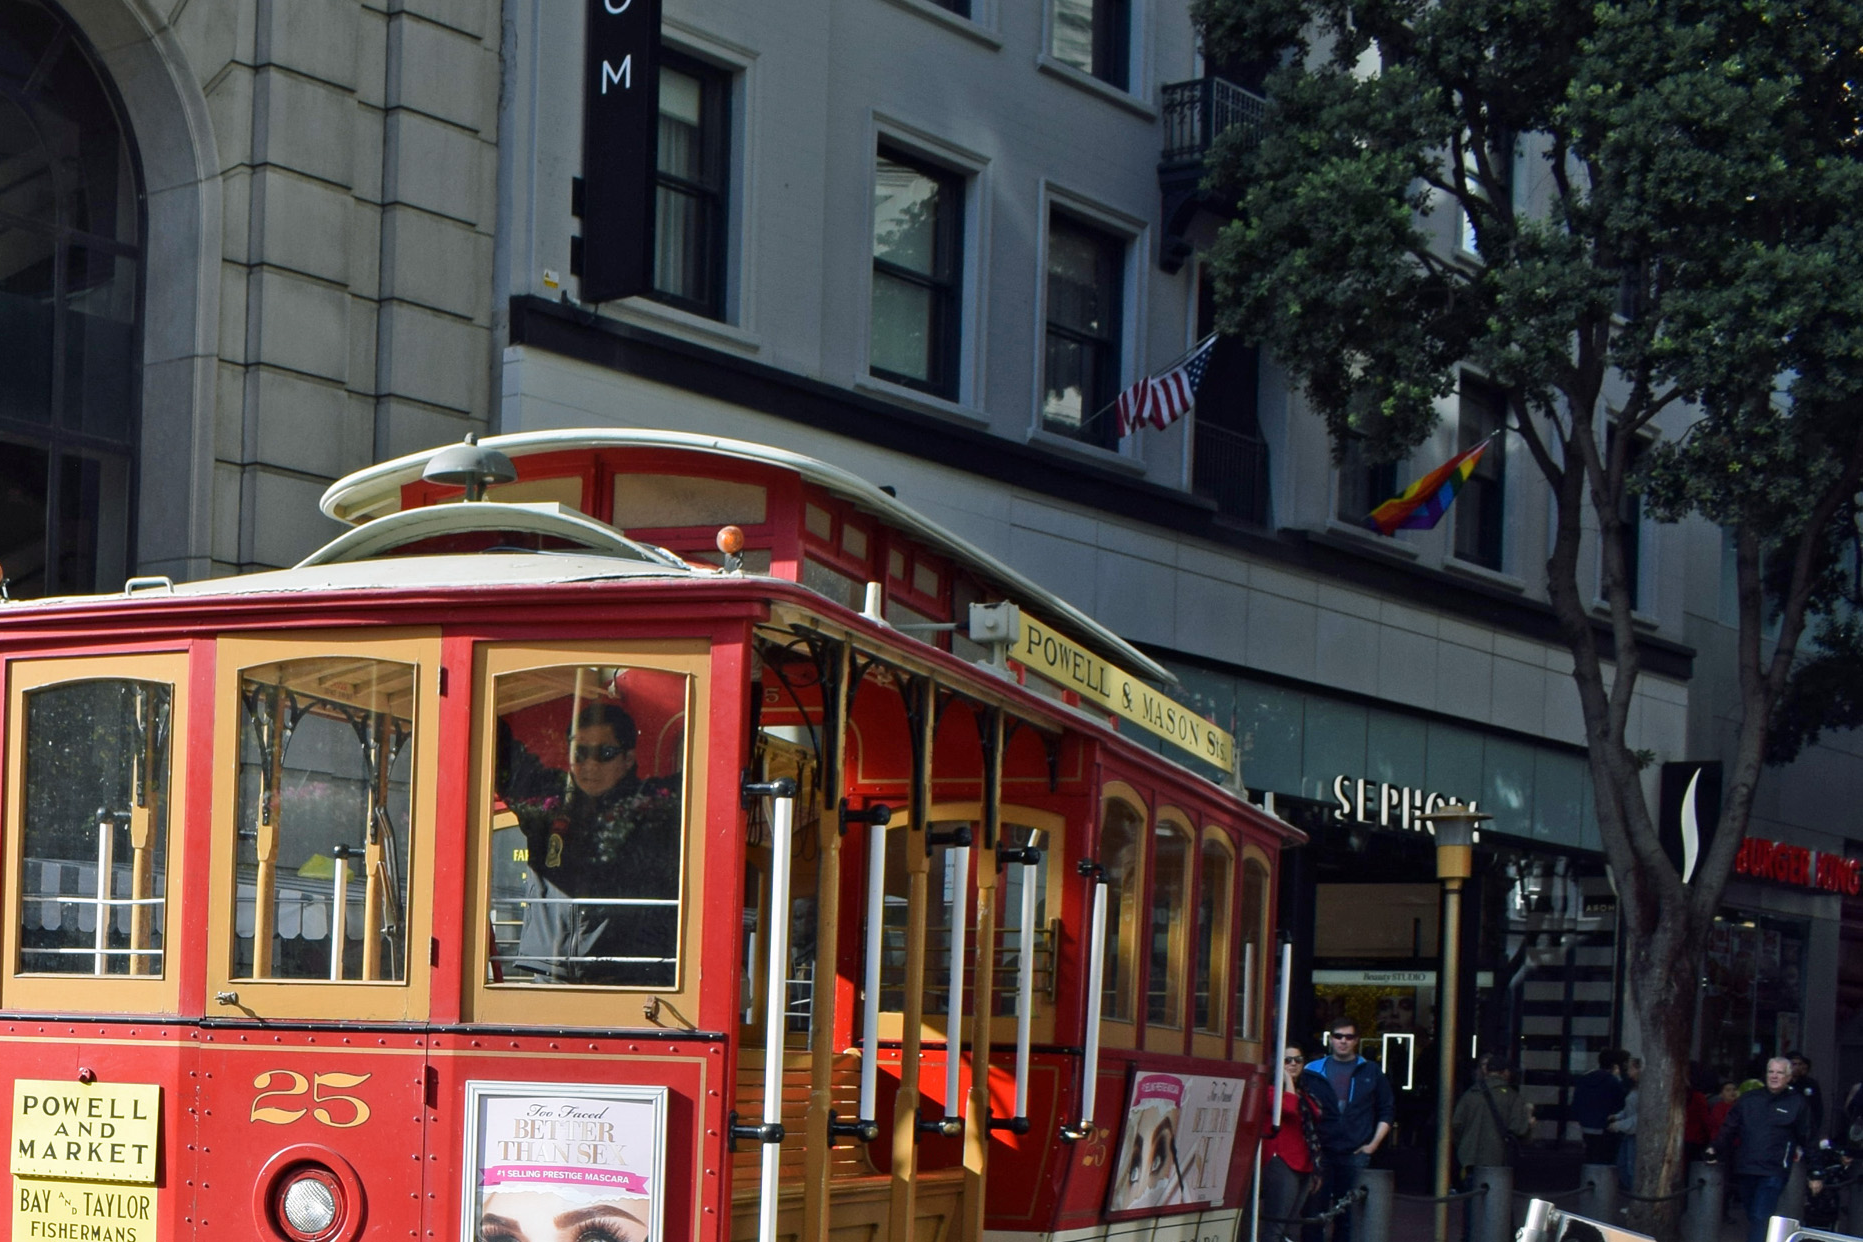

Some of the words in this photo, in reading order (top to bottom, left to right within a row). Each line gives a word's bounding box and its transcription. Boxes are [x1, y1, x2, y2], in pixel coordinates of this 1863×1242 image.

[764, 687, 779, 702] 5
[1026, 624, 1111, 699] POWELL
[1121, 681, 1133, 713] &
[1142, 692, 1200, 747] MASON
[1332, 774, 1481, 844] SEPHOA
[1735, 836, 1811, 887] BURGER
[1815, 850, 1861, 896] KING
[1391, 973, 1426, 982] STUDIO
[22, 1095, 147, 1120] POWELL
[249, 1068, 373, 1129] 25
[526, 1103, 554, 1118] Too
[558, 1105, 610, 1120] Faced
[53, 1122, 116, 1139] AND
[513, 1118, 616, 1143] BETTER
[19, 1139, 148, 1165] MARKET
[497, 1141, 571, 1164] THAN
[576, 1142, 628, 1166] SEX
[496, 1169, 506, 1178] #1
[507, 1169, 541, 1179] SELLING
[542, 1171, 583, 1181] PRESTIGE
[584, 1172, 630, 1184] MASCARA
[20, 1188, 51, 1214] BAY
[83, 1192, 150, 1220] TAYLOR
